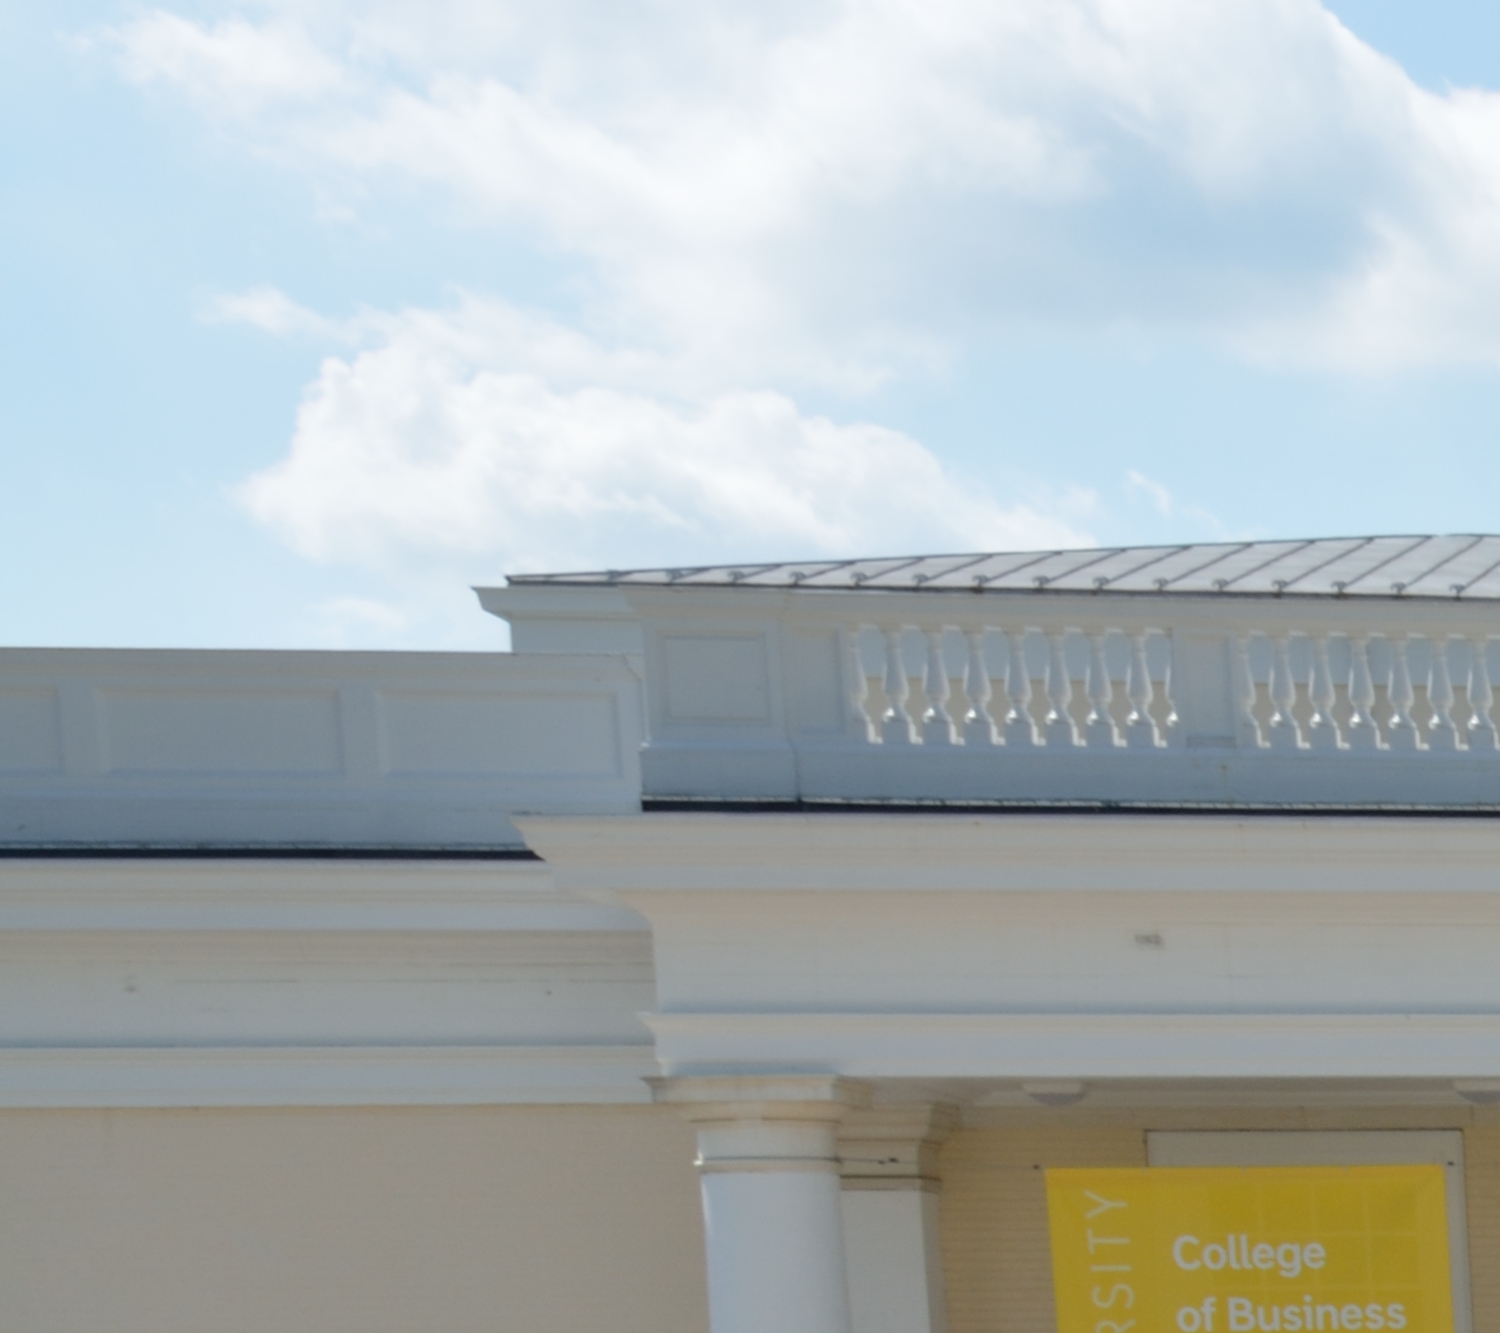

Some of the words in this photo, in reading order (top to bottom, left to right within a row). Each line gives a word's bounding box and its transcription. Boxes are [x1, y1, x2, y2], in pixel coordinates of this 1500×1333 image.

[1172, 1235, 1326, 1279] College
[1176, 1298, 1216, 1333] of
[1226, 1297, 1407, 1333] Business
